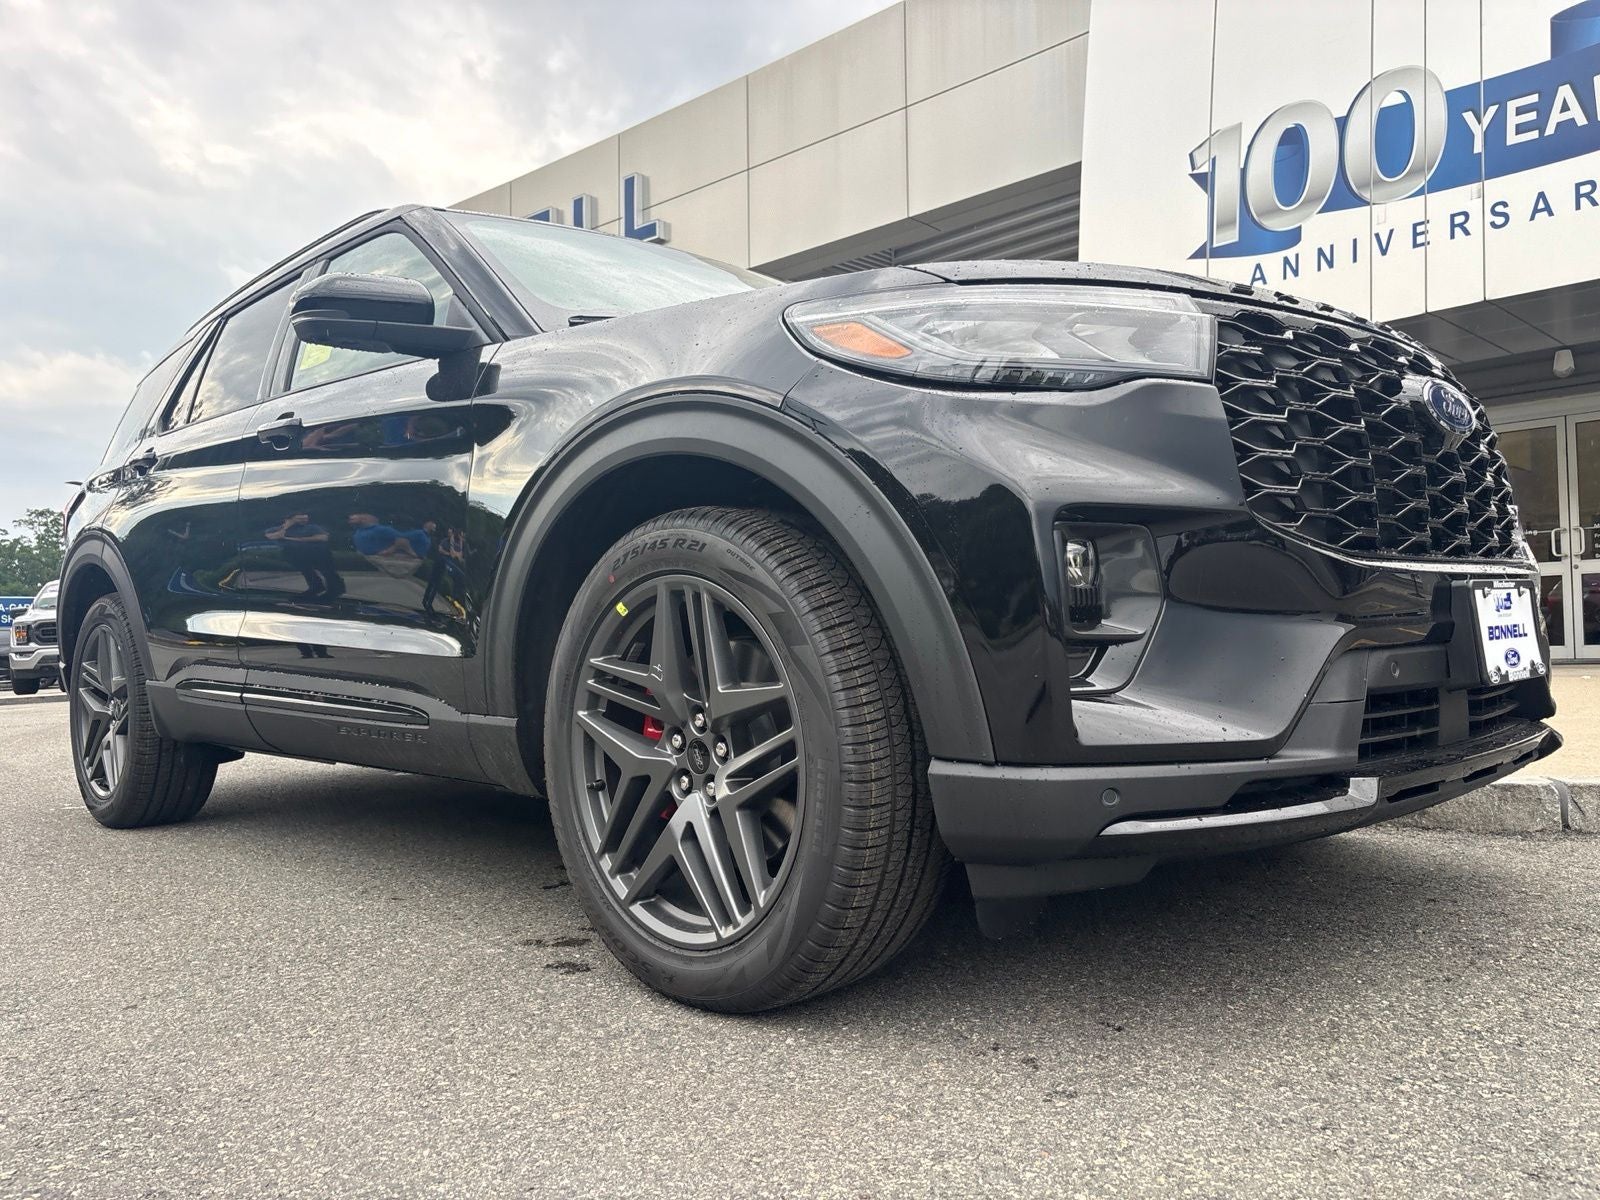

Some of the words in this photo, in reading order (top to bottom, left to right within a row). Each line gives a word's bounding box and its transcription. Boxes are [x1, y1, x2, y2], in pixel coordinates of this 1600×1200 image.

[1188, 65, 1447, 248] 100
[1462, 73, 1600, 154] YEA
[1250, 180, 1600, 286] ANNIVERSAR
[612, 538, 670, 572] 275/45
[672, 538, 707, 553] R21
[1488, 624, 1528, 641] BONNELL
[337, 725, 427, 744] EXPLORER
